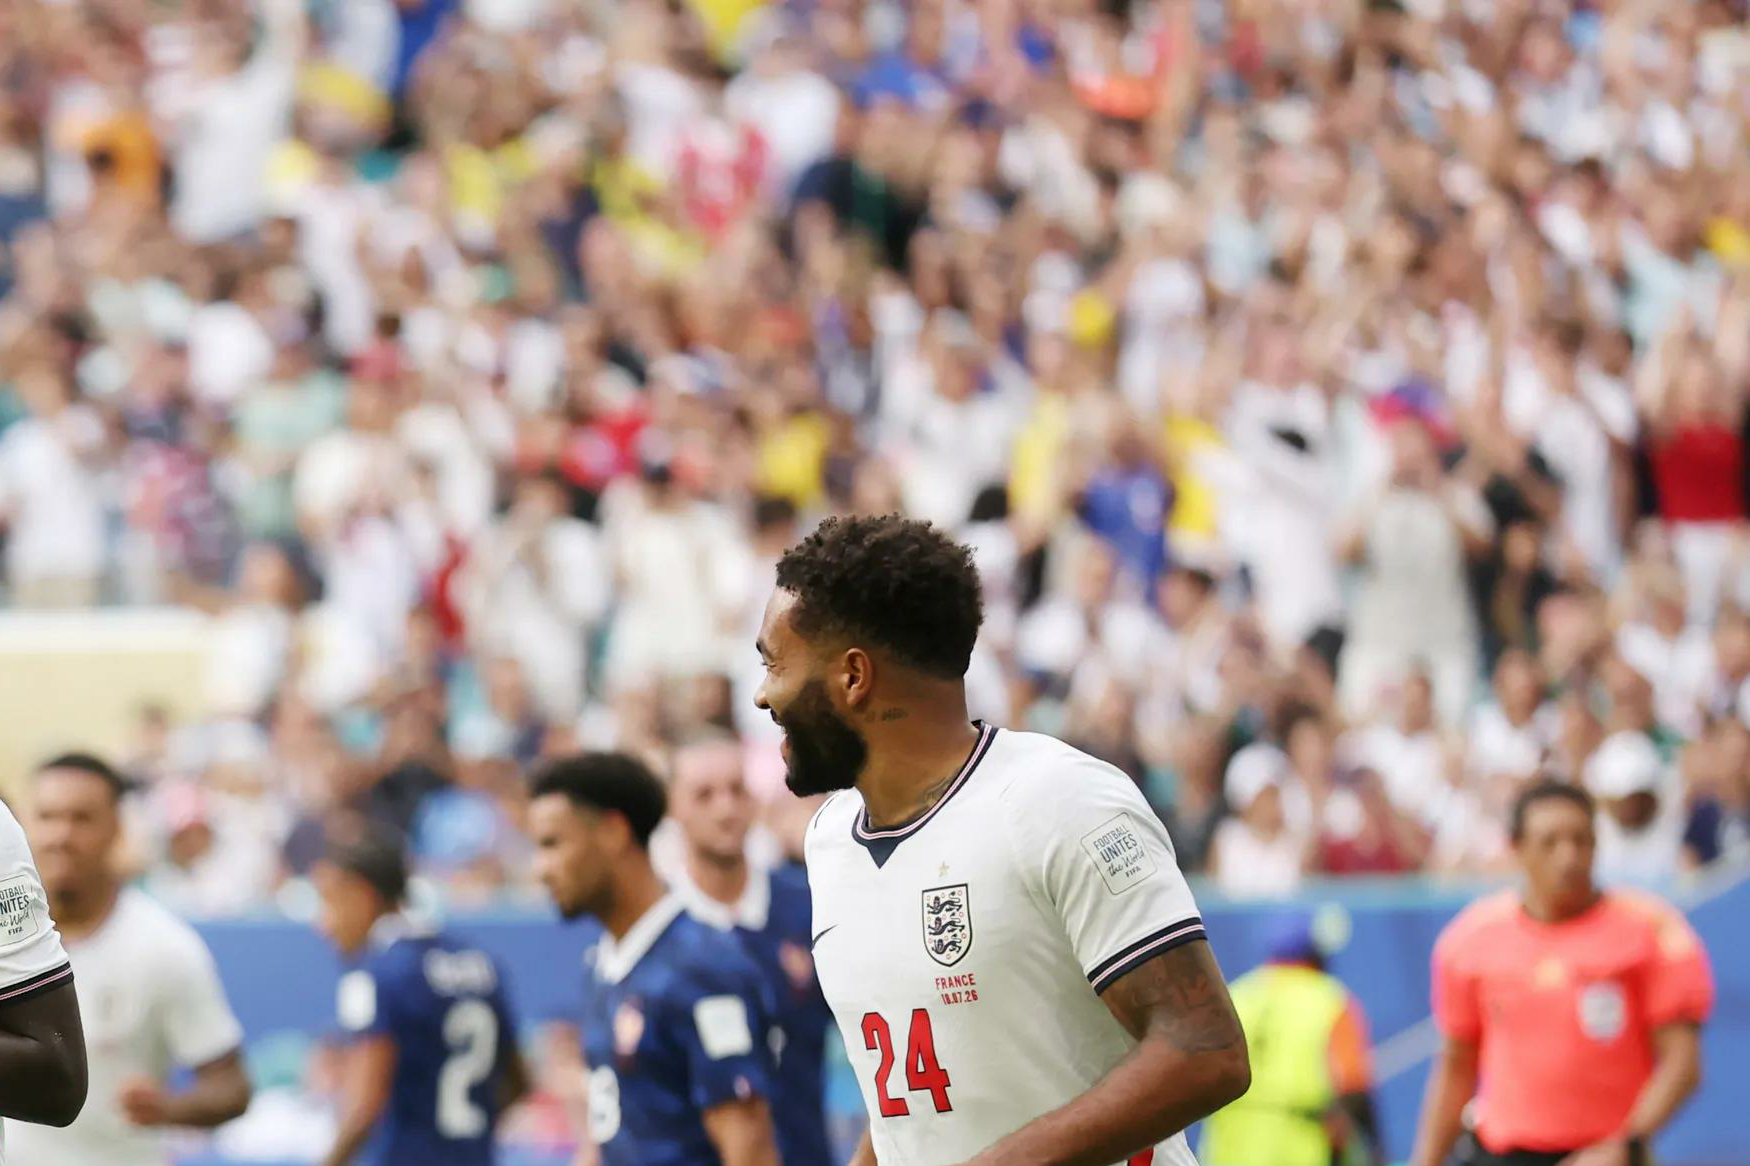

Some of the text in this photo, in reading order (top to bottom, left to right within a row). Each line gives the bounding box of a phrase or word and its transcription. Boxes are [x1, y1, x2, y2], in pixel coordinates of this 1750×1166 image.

[1093, 824, 1130, 850] FOOTBALL
[1100, 833, 1138, 863] UNITES
[935, 973, 976, 990] FRANCE
[436, 999, 498, 1142] 2
[861, 1008, 953, 1117] 24
